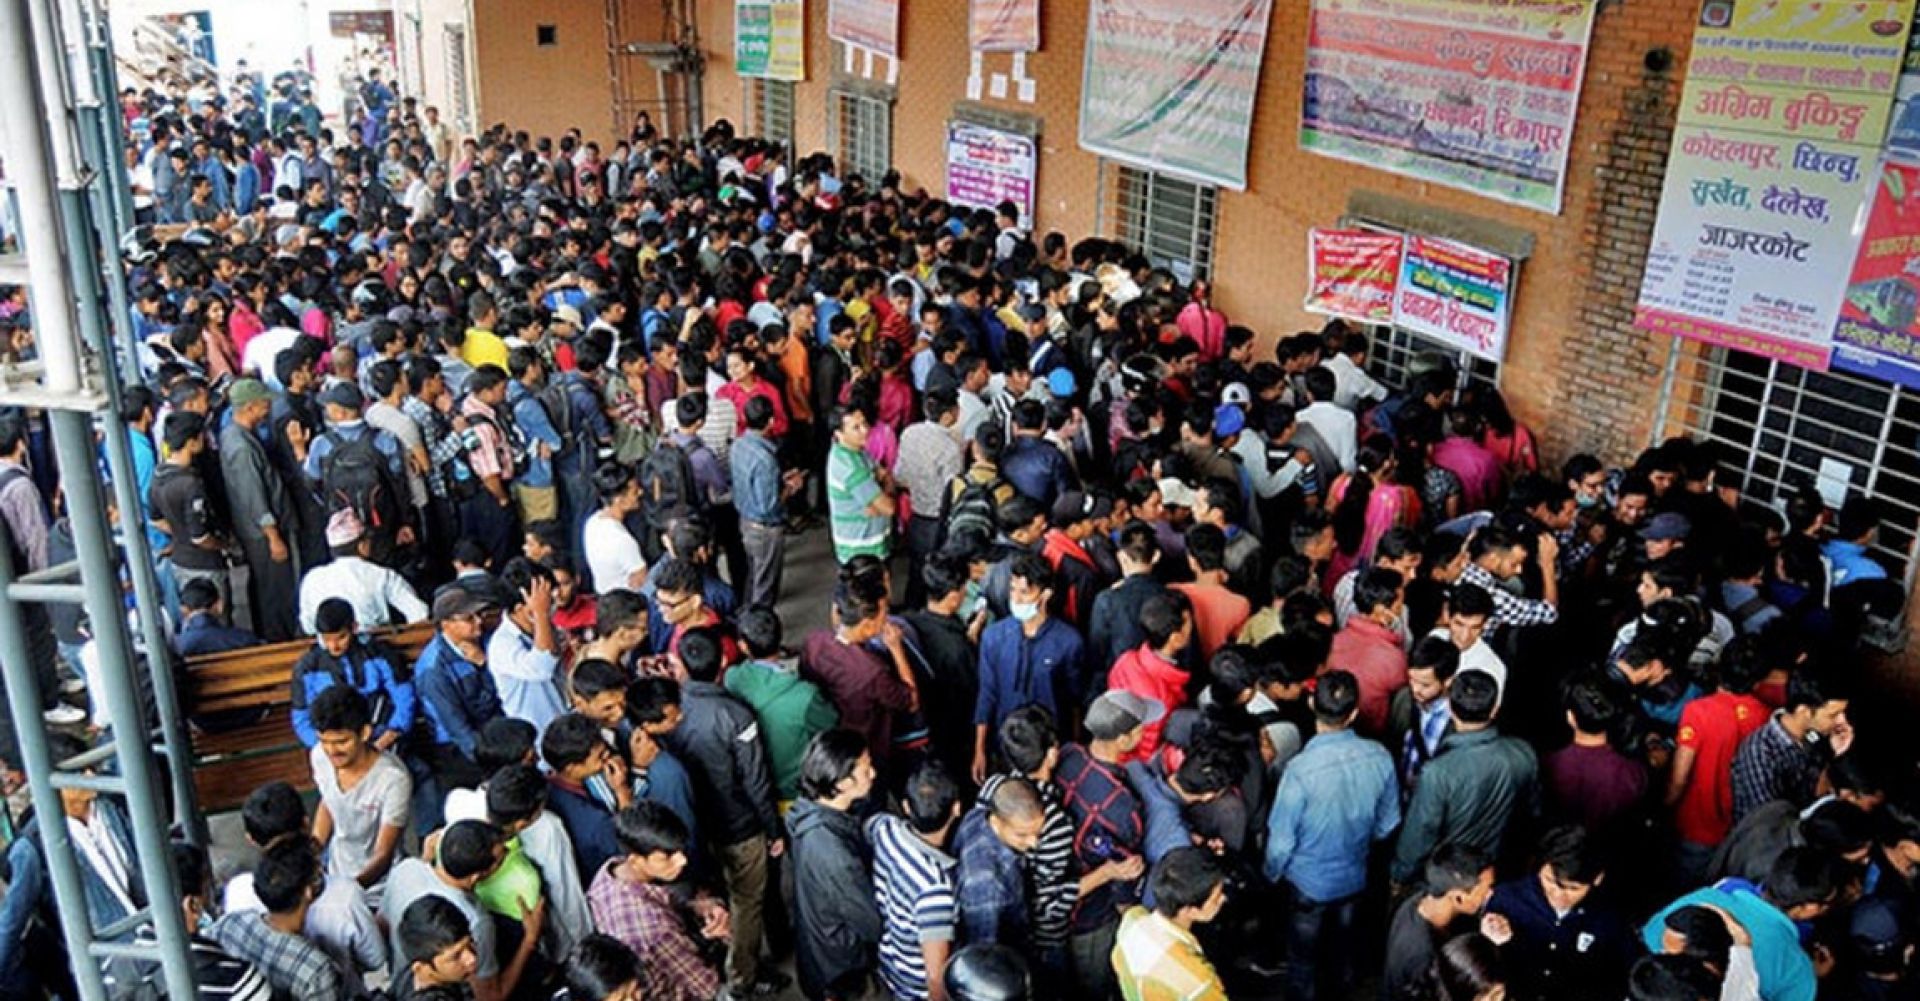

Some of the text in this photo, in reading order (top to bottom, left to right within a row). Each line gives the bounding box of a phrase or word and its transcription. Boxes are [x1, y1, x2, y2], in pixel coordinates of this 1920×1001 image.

[1694, 84, 1774, 120] अग्रिम
[1683, 133, 1782, 171] कोहलपुर,
[1760, 182, 1830, 224] दैलेख,
[1699, 222, 1812, 263] जाजरकोट
